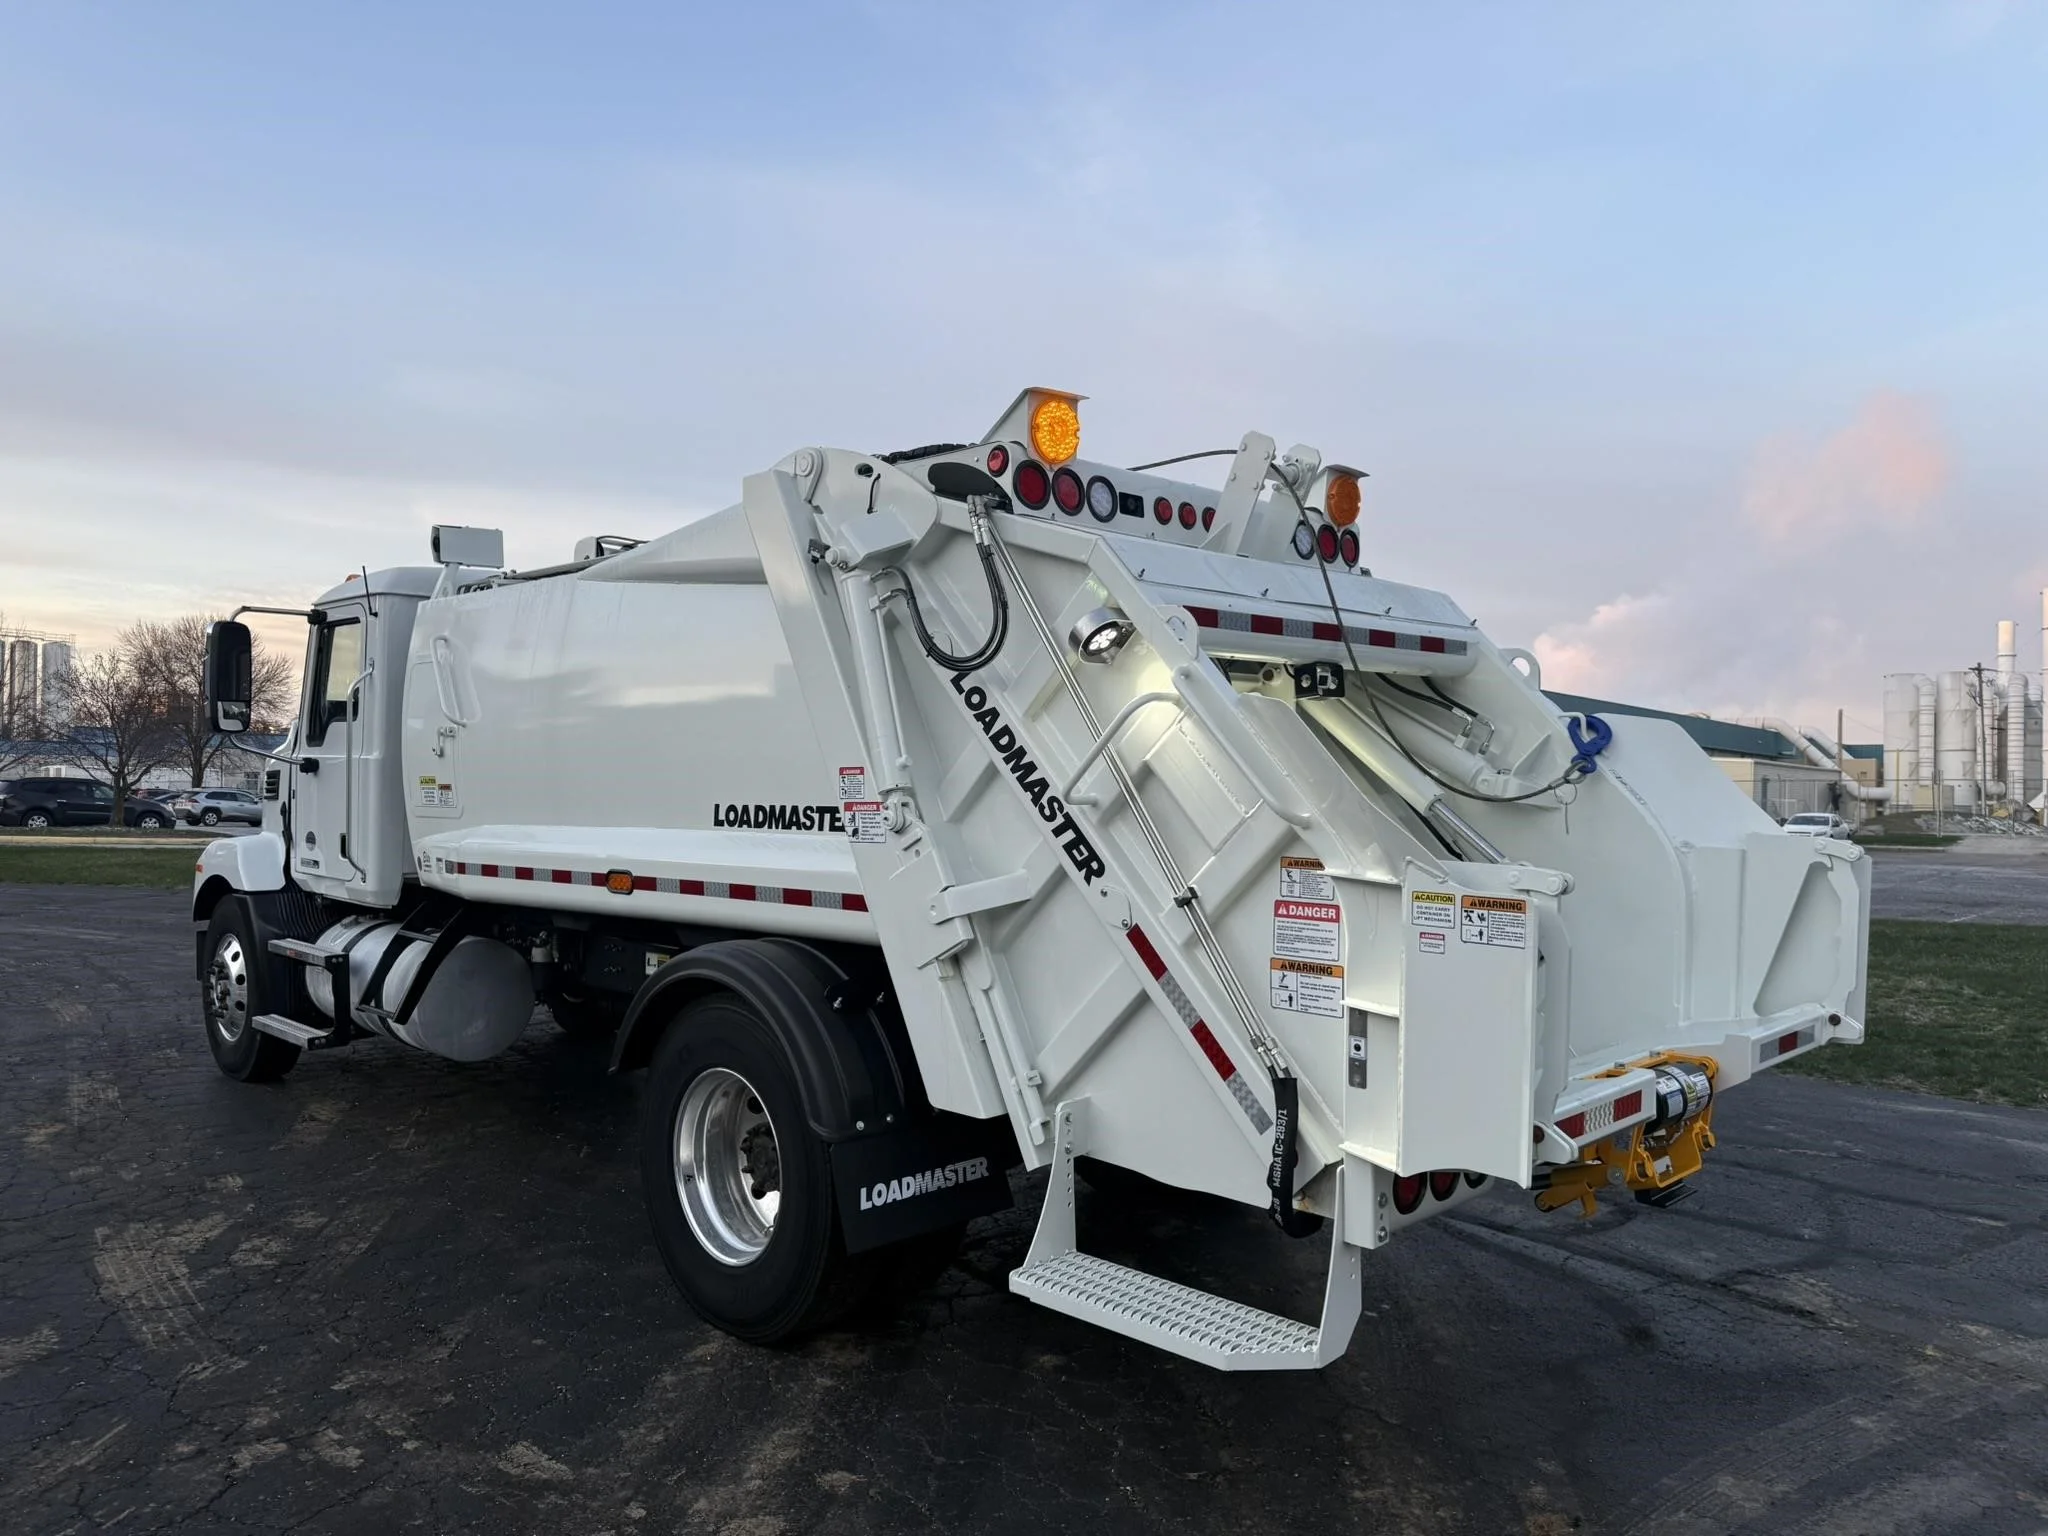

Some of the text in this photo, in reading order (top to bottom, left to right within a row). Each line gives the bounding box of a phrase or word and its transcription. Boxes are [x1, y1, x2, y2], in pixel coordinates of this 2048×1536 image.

[950, 670, 1106, 887] LOADMASTER
[713, 803, 847, 832] LOADMASTE
[1294, 859, 1325, 869] WARNIN
[1420, 893, 1453, 903] CAUTION
[1477, 899, 1522, 911] WARNING
[1288, 905, 1336, 919] DANGER
[1287, 961, 1333, 976] WARNING
[1273, 1156, 1283, 1188] MSHA
[859, 1156, 989, 1211] LOADMASTER
